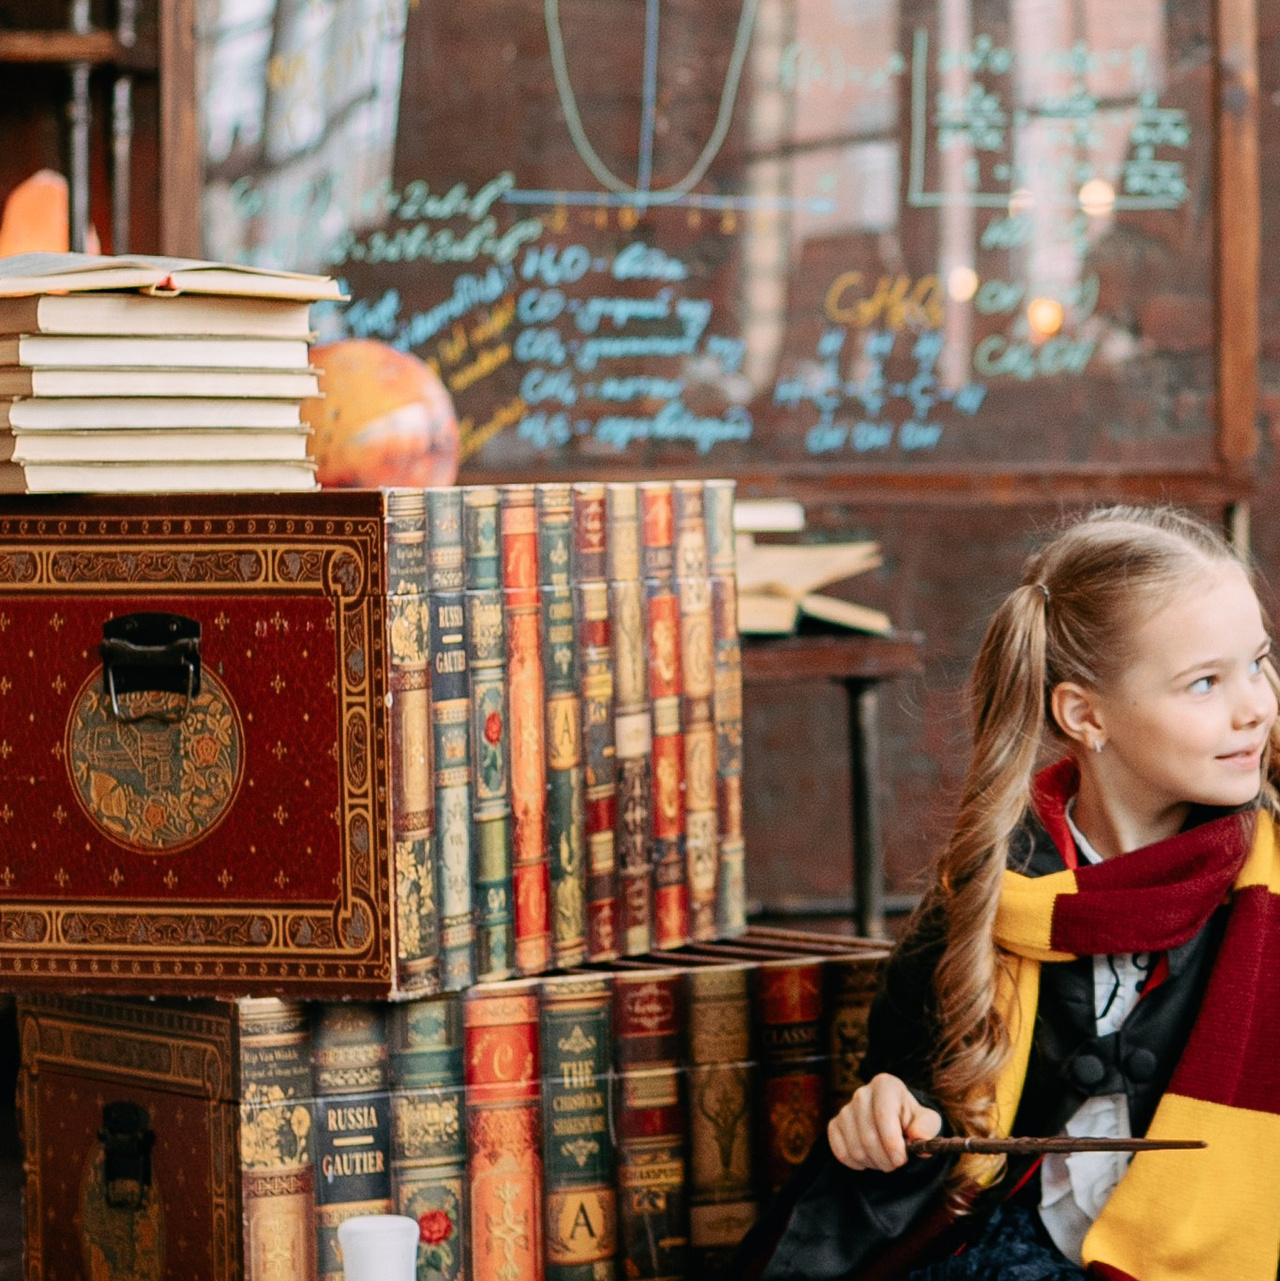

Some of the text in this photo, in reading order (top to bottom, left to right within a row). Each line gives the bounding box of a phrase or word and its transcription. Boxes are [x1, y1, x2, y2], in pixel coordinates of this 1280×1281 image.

[560, 1060, 596, 1089] THE
[327, 1105, 379, 1132] RUSSIA
[322, 1150, 385, 1177] GAUTIER
[569, 1200, 597, 1240] A
